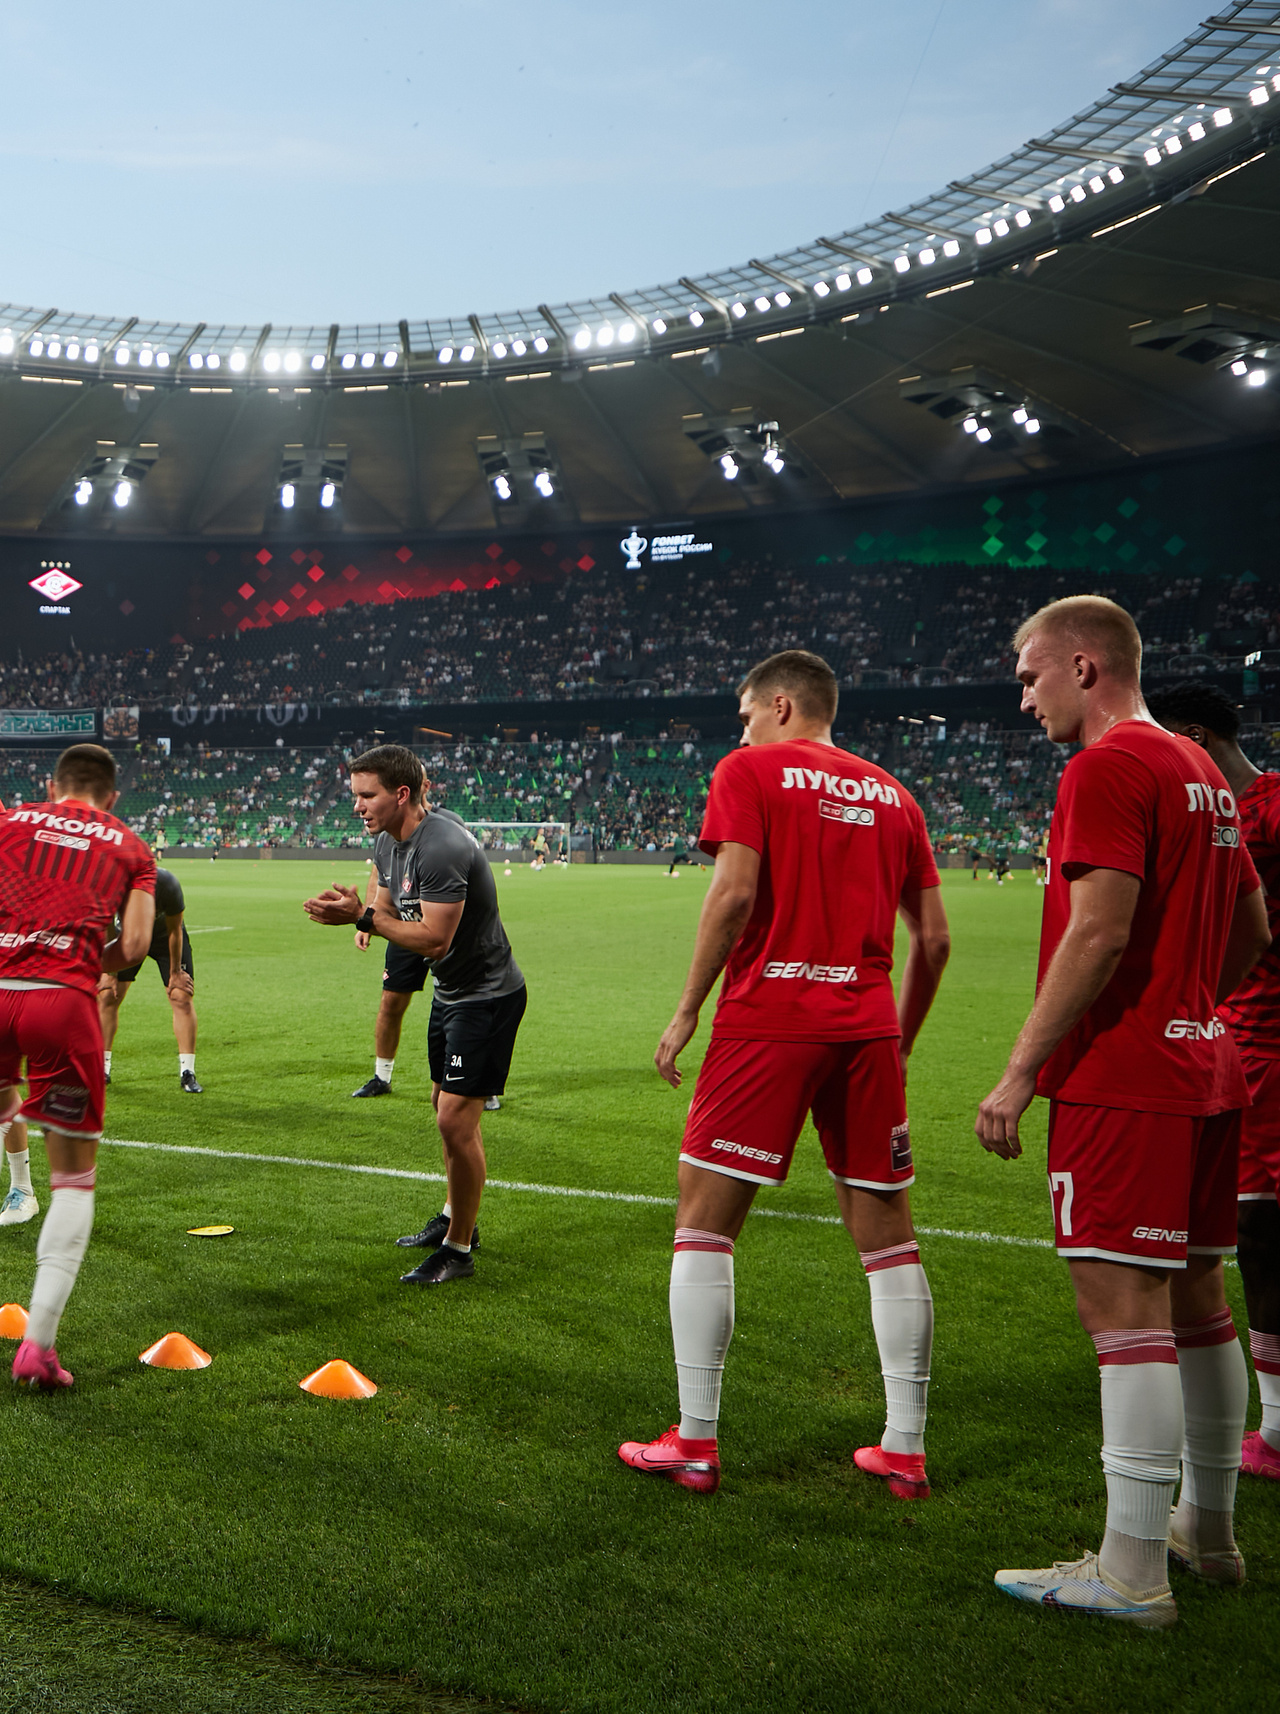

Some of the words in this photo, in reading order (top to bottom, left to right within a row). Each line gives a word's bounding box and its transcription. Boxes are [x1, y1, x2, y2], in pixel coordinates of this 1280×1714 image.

[651, 534, 695, 547] FONBET
[40, 605, 71, 614] СПАРТАК
[782, 767, 901, 808] ЛУКОЙЛ
[8, 811, 124, 845] ЛУКОЙЛ
[711, 1138, 783, 1164] GENESIS
[1048, 1172, 1074, 1236] 7
